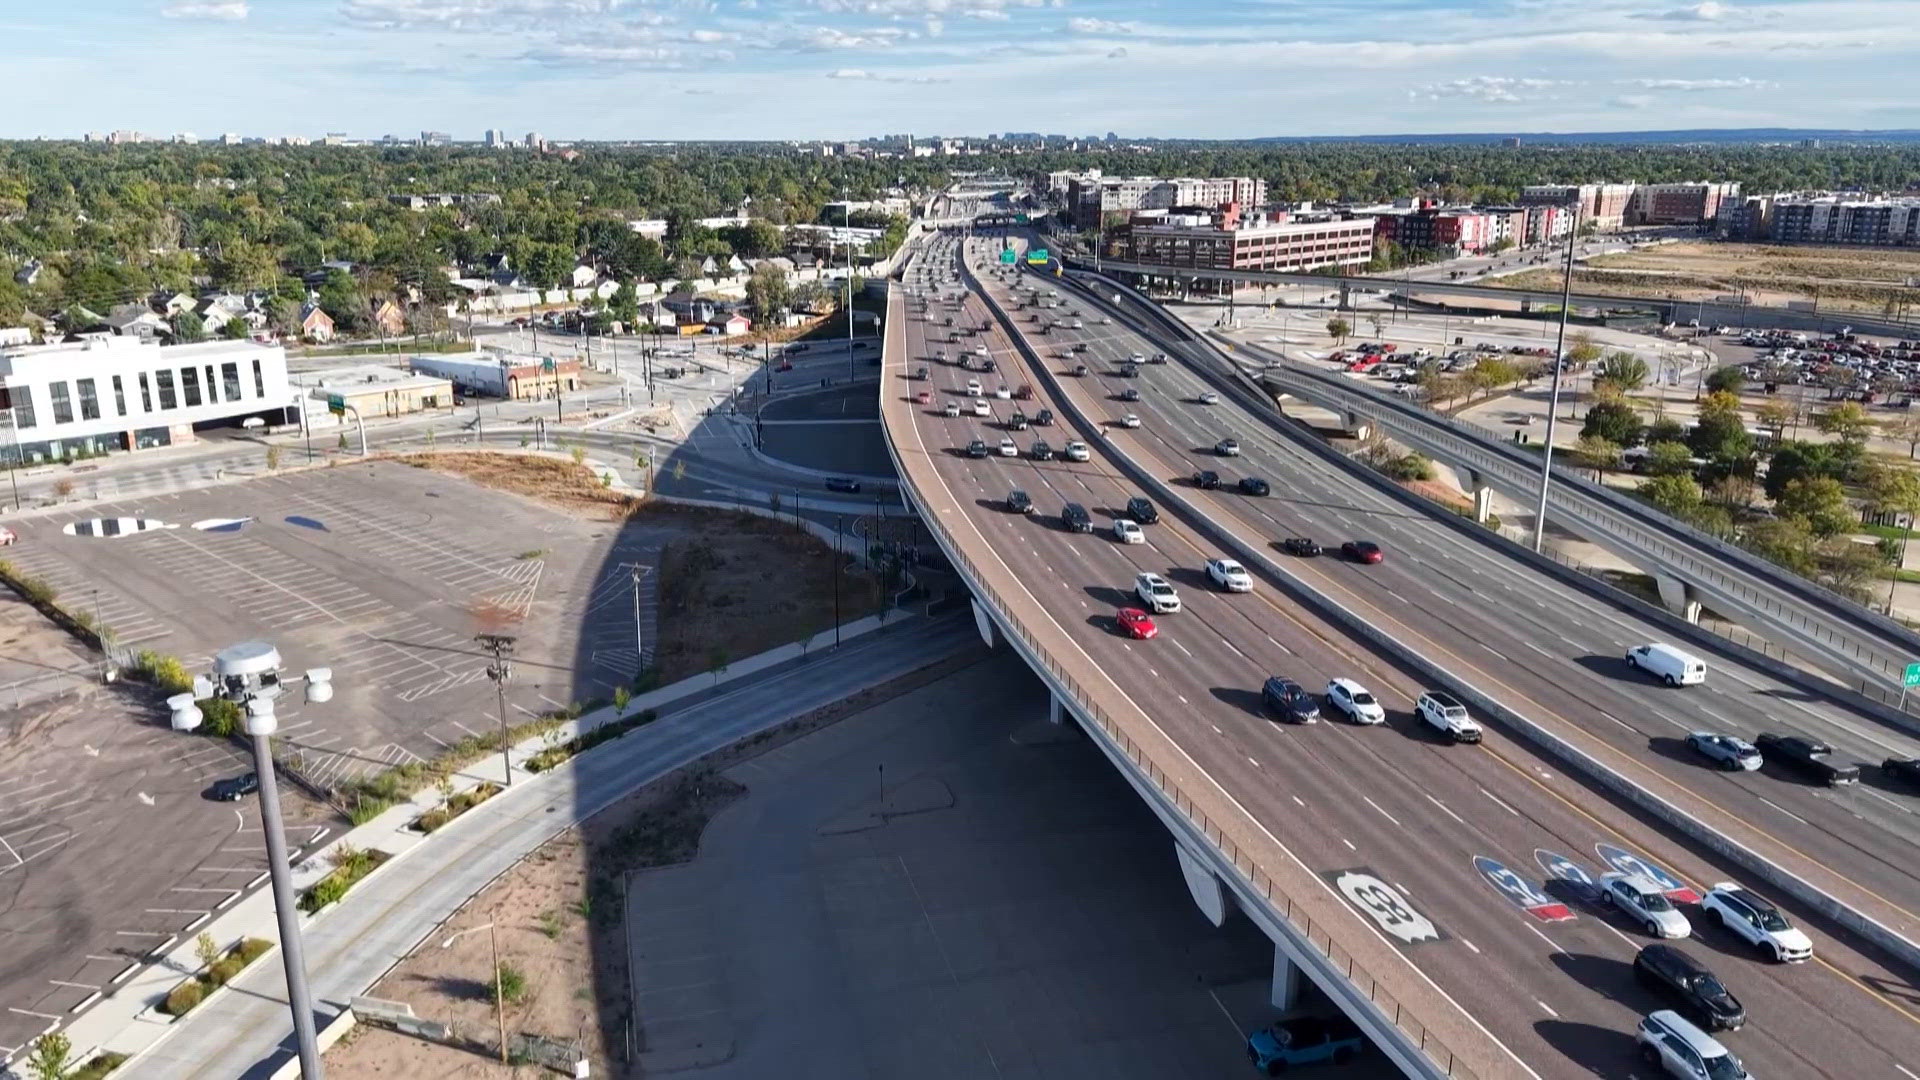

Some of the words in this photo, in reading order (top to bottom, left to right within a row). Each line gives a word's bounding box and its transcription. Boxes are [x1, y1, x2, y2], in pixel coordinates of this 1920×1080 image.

[1907, 674, 1920, 684] 20
[1355, 885, 1413, 925] 85
[1488, 868, 1548, 906] 25
